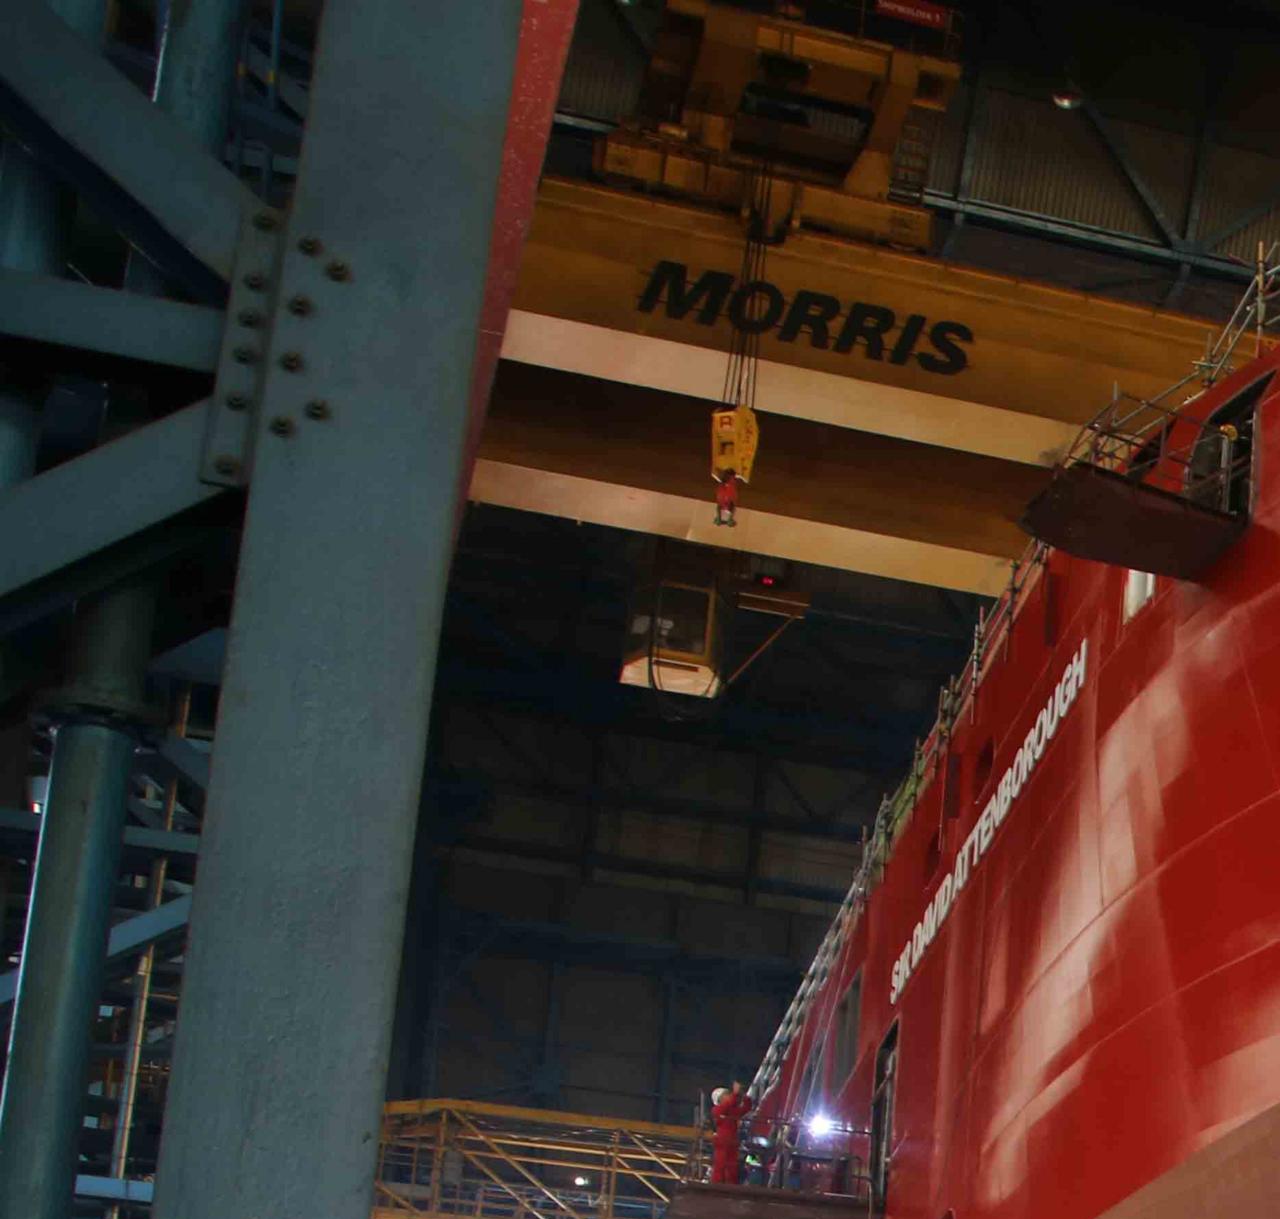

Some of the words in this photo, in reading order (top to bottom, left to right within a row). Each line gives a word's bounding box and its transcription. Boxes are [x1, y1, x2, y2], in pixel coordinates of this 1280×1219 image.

[637, 261, 974, 375] MORRIS
[911, 873, 952, 970] DAVID
[951, 638, 1087, 900] ATTENBOROUGH
